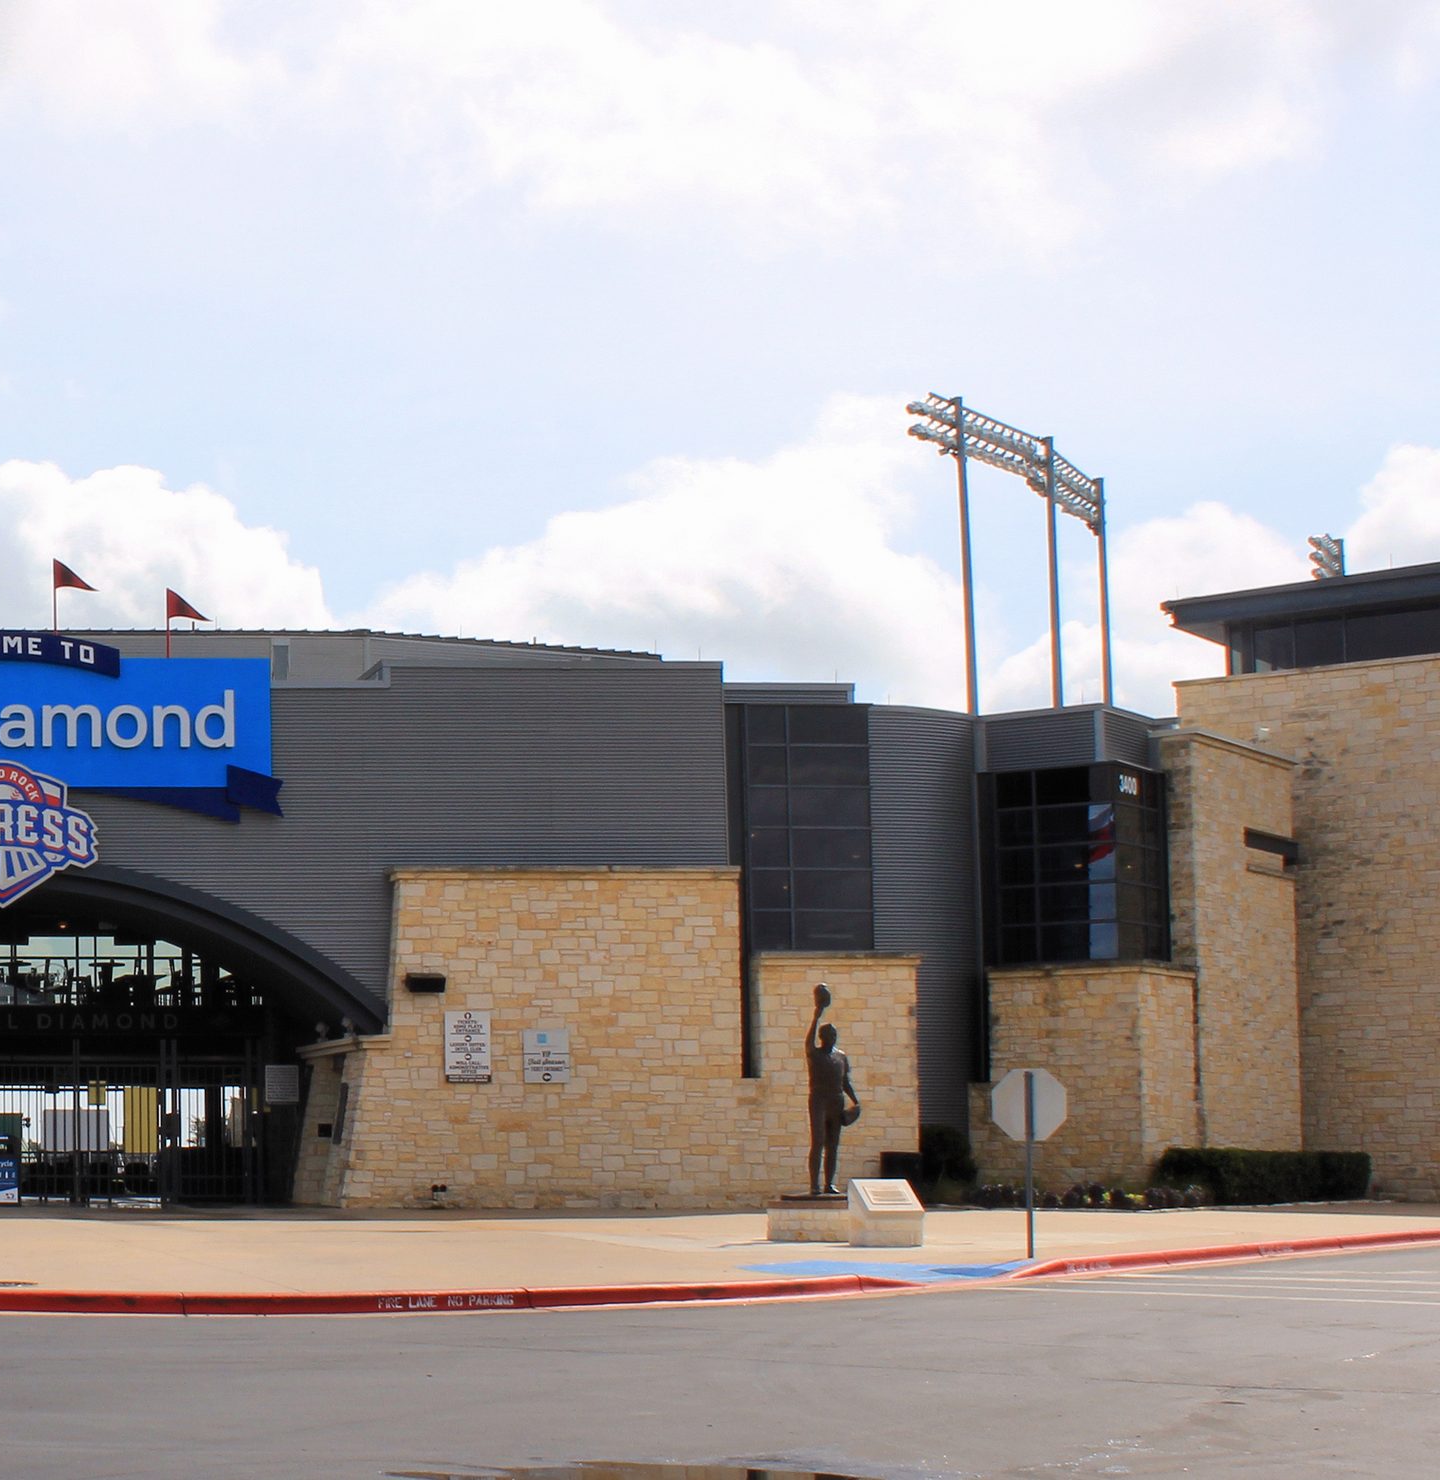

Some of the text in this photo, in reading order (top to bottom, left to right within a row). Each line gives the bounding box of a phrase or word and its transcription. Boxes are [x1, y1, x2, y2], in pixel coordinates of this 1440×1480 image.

[60, 641, 95, 665] TO
[10, 770, 40, 800] ROCK
[1119, 774, 1137, 795] 3400
[36, 1012, 178, 1029] DIAMOND
[378, 1294, 514, 1309] FIRE LANE NO PARKING
